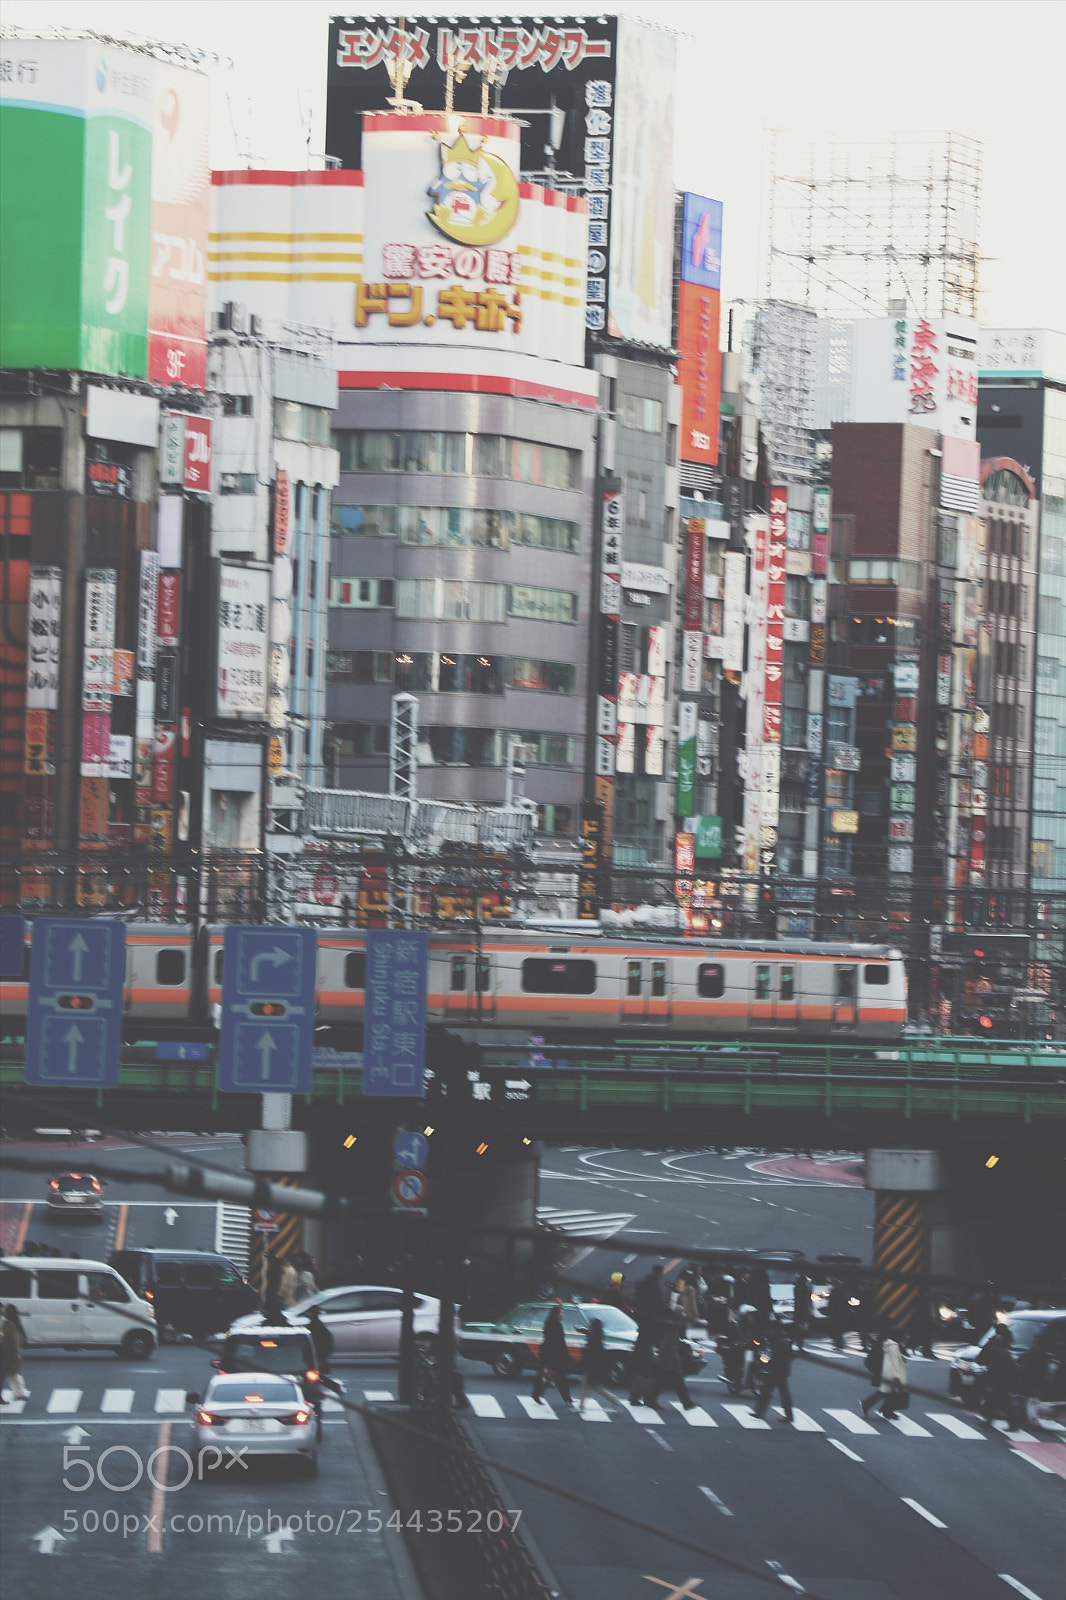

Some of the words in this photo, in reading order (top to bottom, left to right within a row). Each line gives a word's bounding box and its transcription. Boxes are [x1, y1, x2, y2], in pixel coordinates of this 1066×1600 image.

[104, 130, 133, 315] レイク
[152, 231, 204, 285] アコム
[166, 349, 186, 378] 3F
[767, 498, 787, 580] カラオケ
[370, 942, 393, 1016] Shinjuku
[391, 939, 420, 1086] 新宿駅東口
